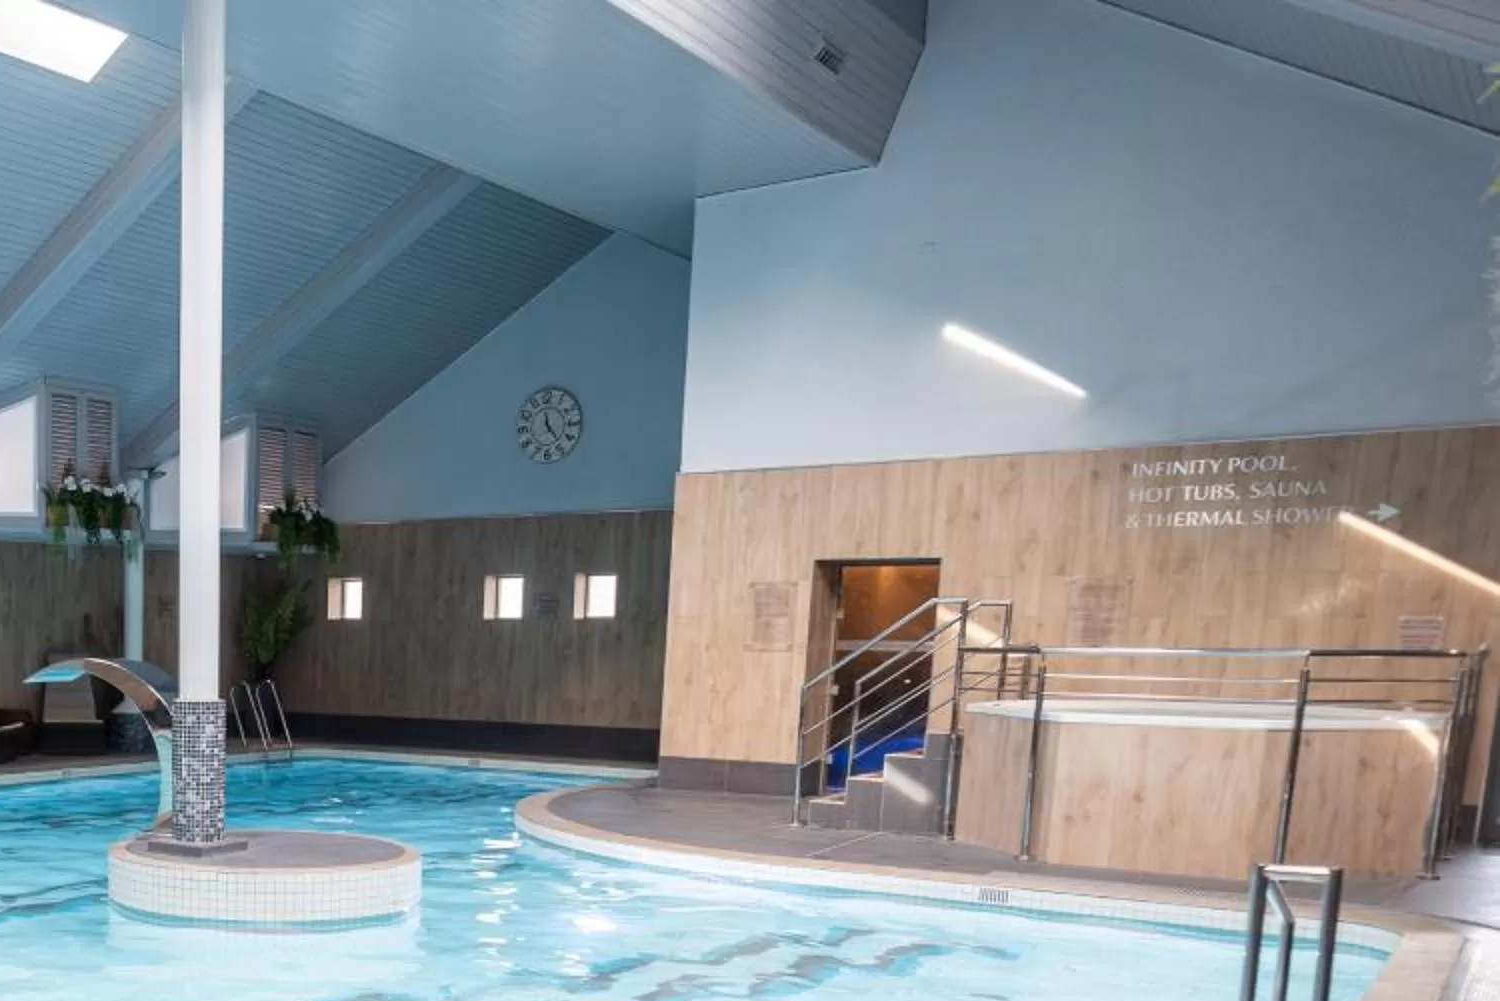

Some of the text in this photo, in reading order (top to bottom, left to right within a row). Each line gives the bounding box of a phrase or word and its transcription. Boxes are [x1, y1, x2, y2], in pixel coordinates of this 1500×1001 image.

[1132, 458, 1221, 477] INFINITY
[1128, 486, 1175, 504] HOT
[1249, 479, 1328, 499] SAUNA
[1125, 512, 1139, 529] &
[1143, 509, 1246, 528] THERMAL
